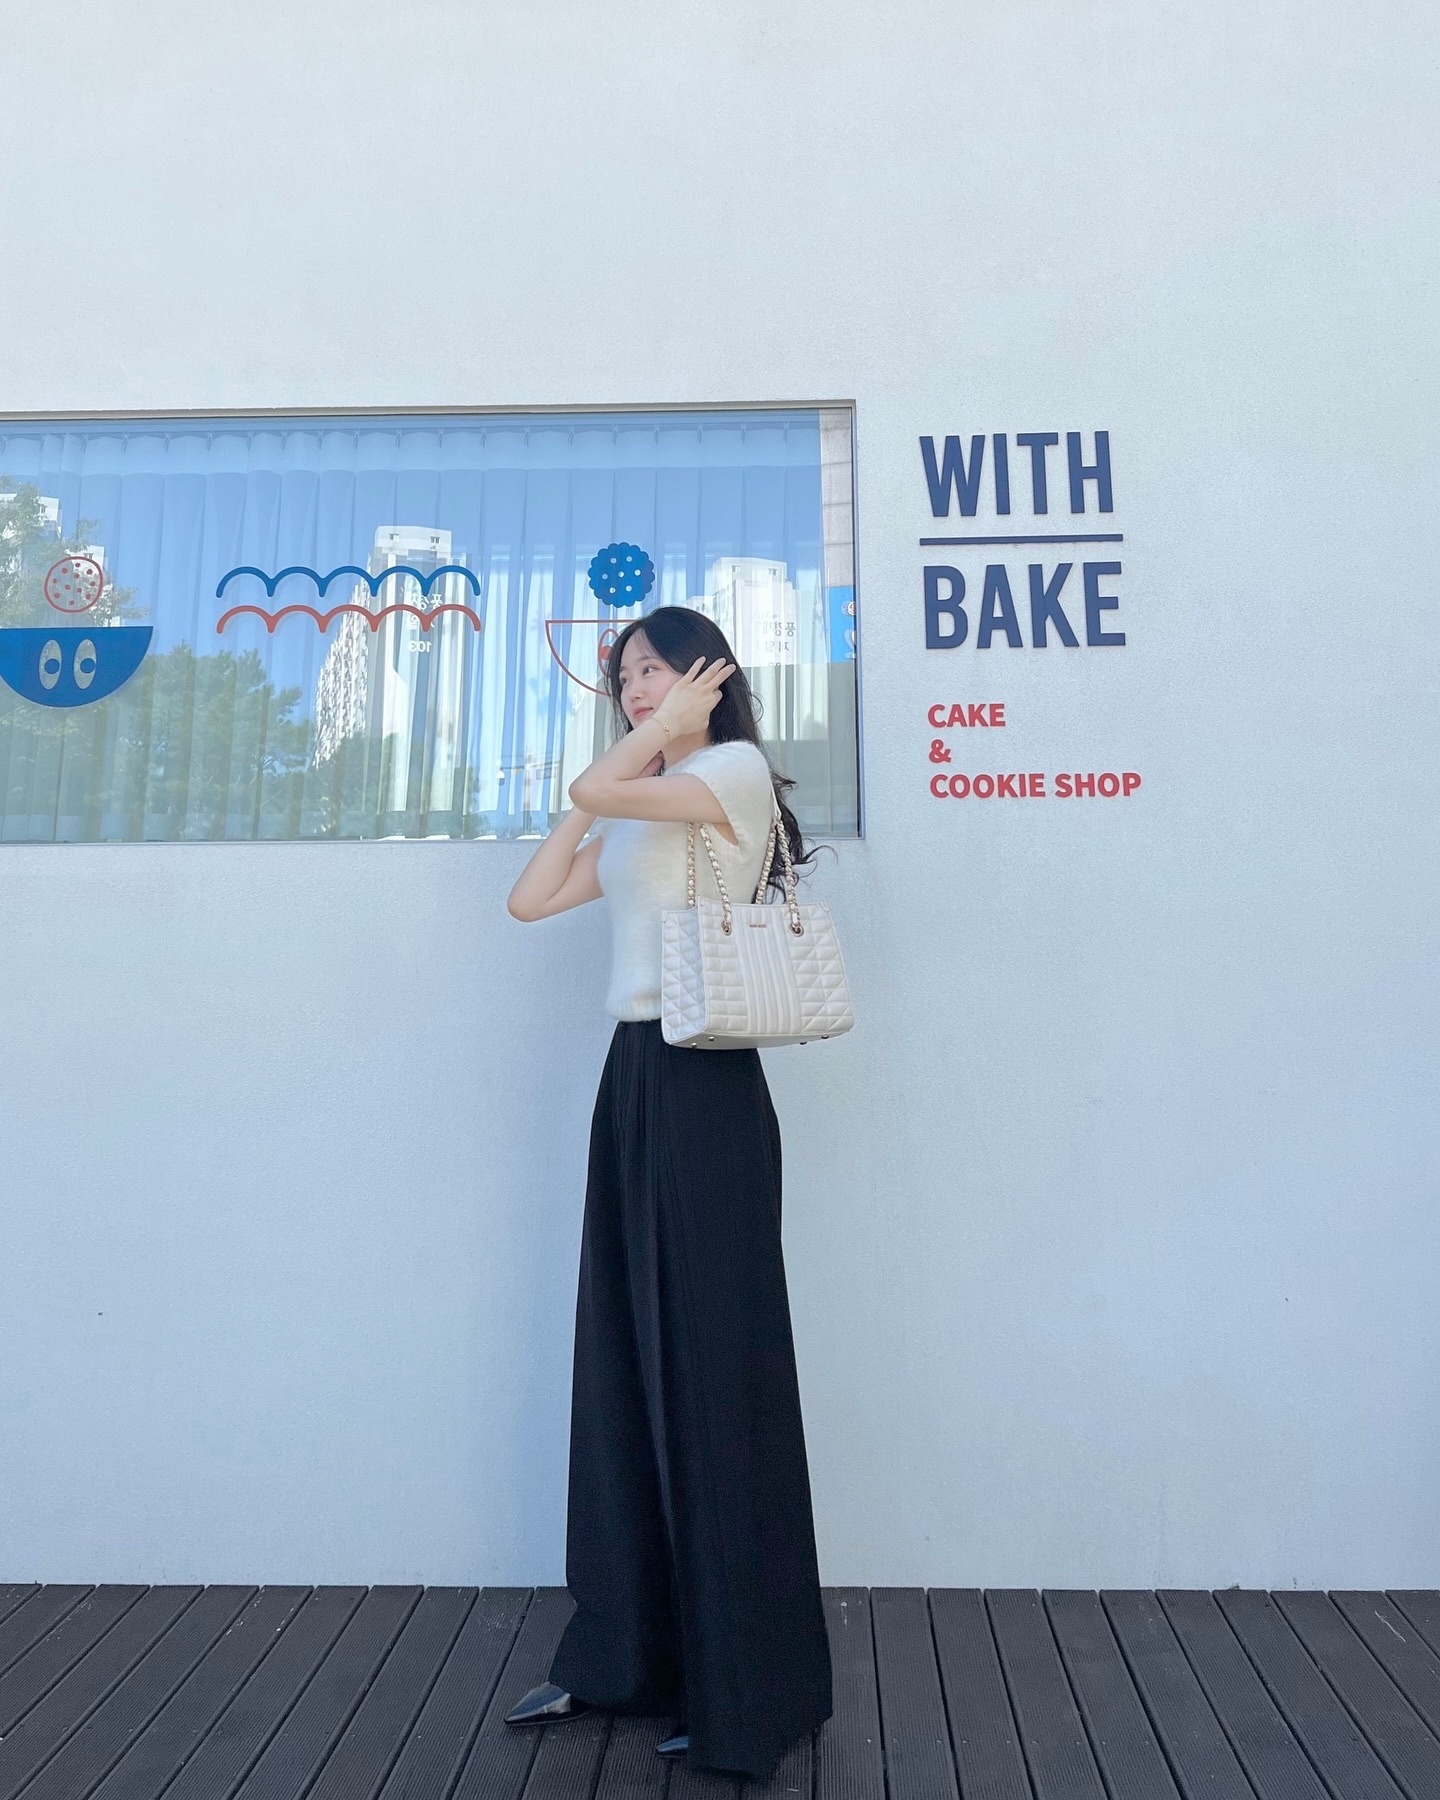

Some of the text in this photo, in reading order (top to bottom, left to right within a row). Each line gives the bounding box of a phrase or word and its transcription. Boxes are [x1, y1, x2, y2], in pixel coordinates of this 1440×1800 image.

[919, 431, 1114, 518] WITH
[923, 561, 1126, 650] BAKE
[928, 703, 1006, 729] CAKE
[928, 738, 952, 763] &
[929, 772, 1142, 799] COOKIE SHOP
